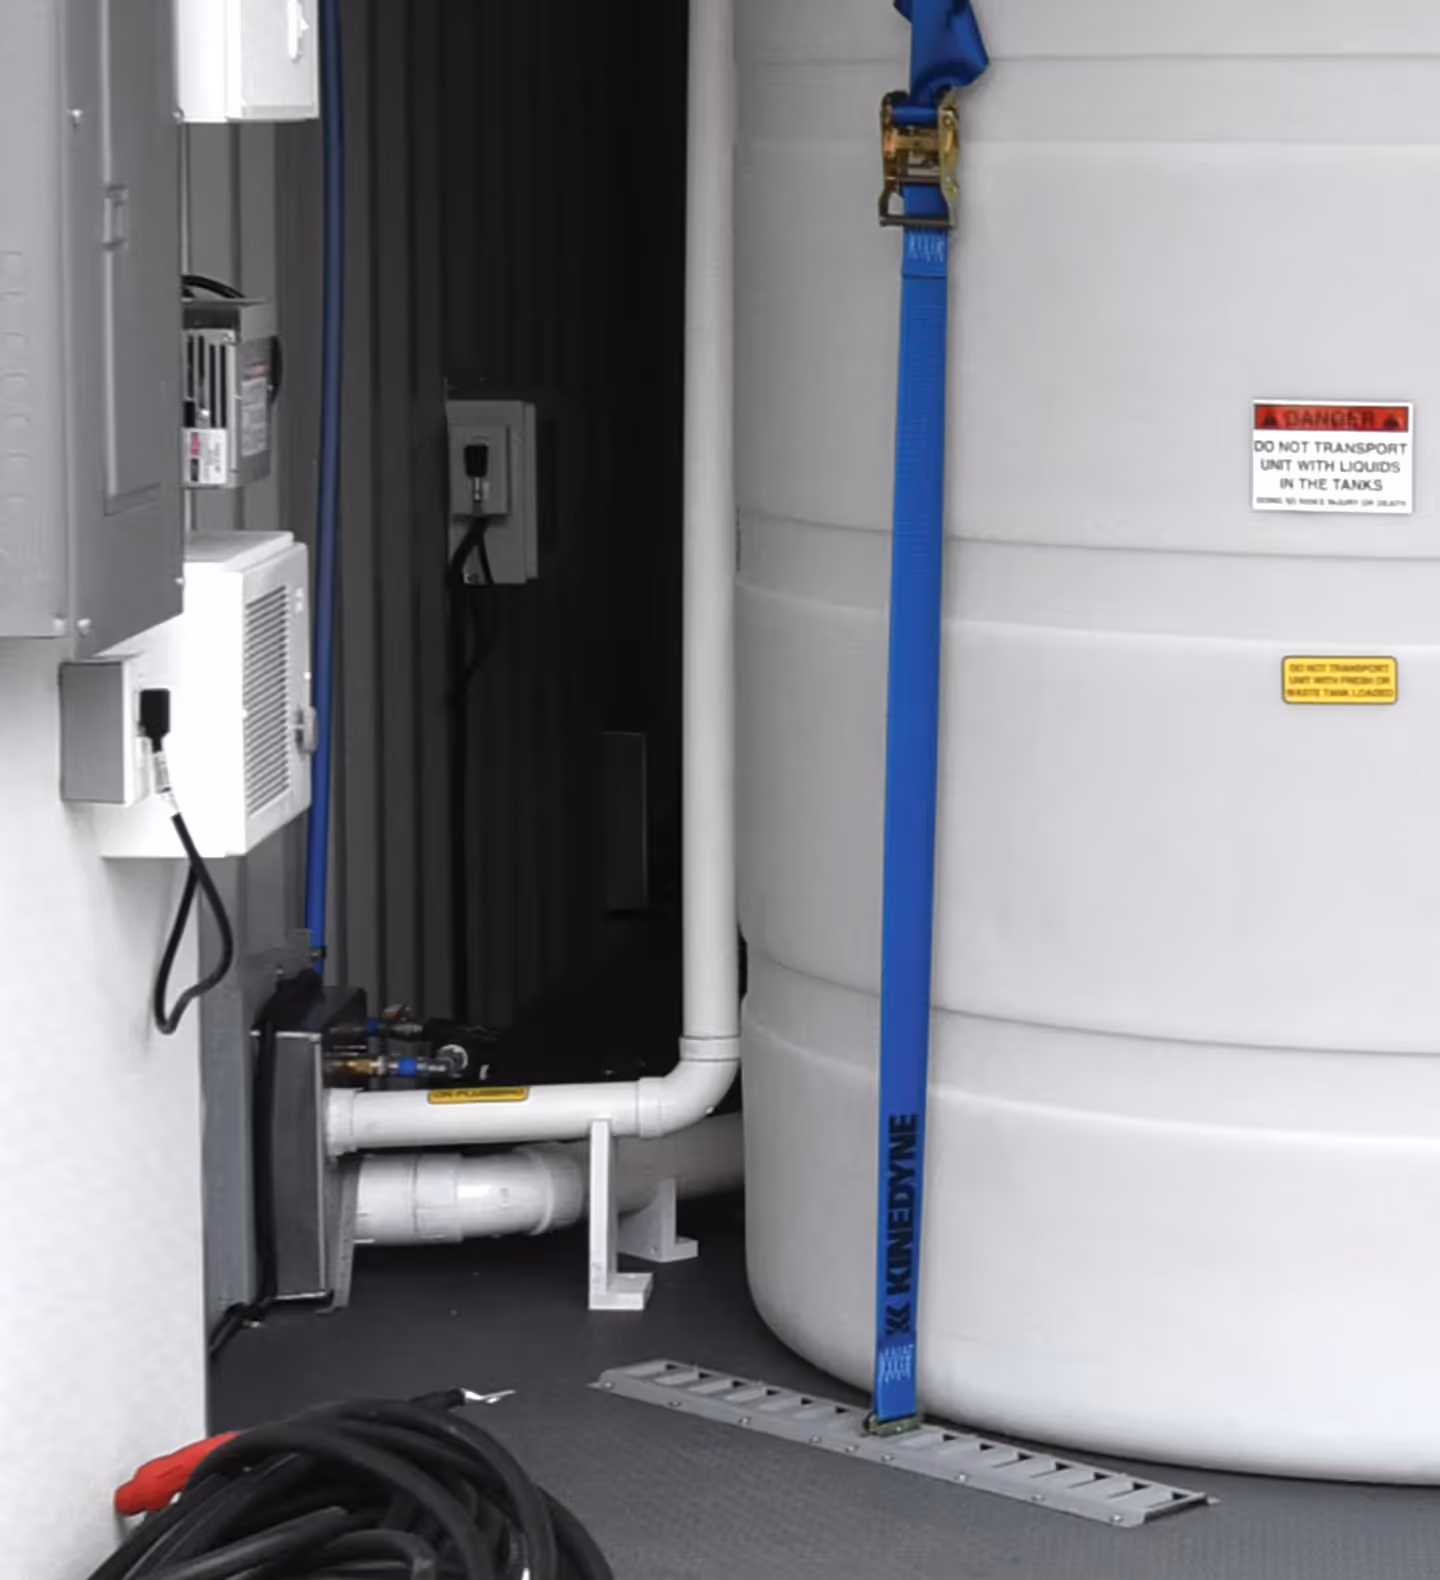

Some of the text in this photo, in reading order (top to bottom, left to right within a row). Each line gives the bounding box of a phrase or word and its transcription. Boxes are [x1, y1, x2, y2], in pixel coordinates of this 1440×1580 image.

[1284, 410, 1374, 428] DANGER
[1254, 440, 1408, 455] DO NOT TRANSPORT
[1260, 458, 1401, 473] UNIT WITH LIQUIDS
[1280, 478, 1383, 491] IN THE TANKS
[1289, 664, 1389, 672] DO NOT TRANSPORT
[1289, 676, 1310, 684] UNIT
[1313, 676, 1339, 684] WITH
[1353, 689, 1394, 697] LOADED
[886, 1114, 918, 1296] KINEDYNE
